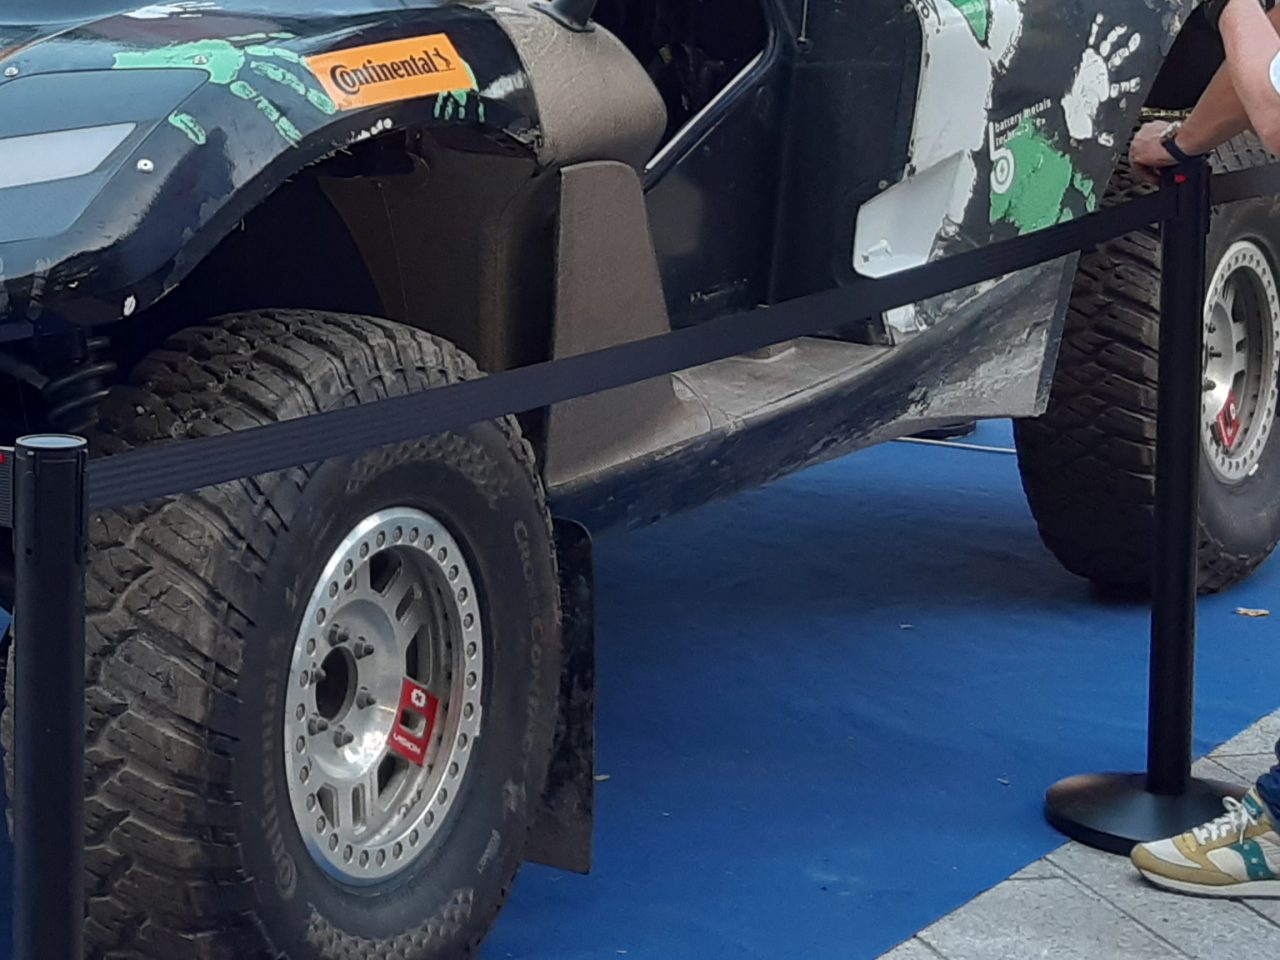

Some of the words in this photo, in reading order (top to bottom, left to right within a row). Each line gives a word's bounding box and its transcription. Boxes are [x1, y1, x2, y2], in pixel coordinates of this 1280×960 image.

[329, 49, 439, 95] Continental
[994, 112, 1022, 133] battery
[1023, 98, 1052, 118] metals
